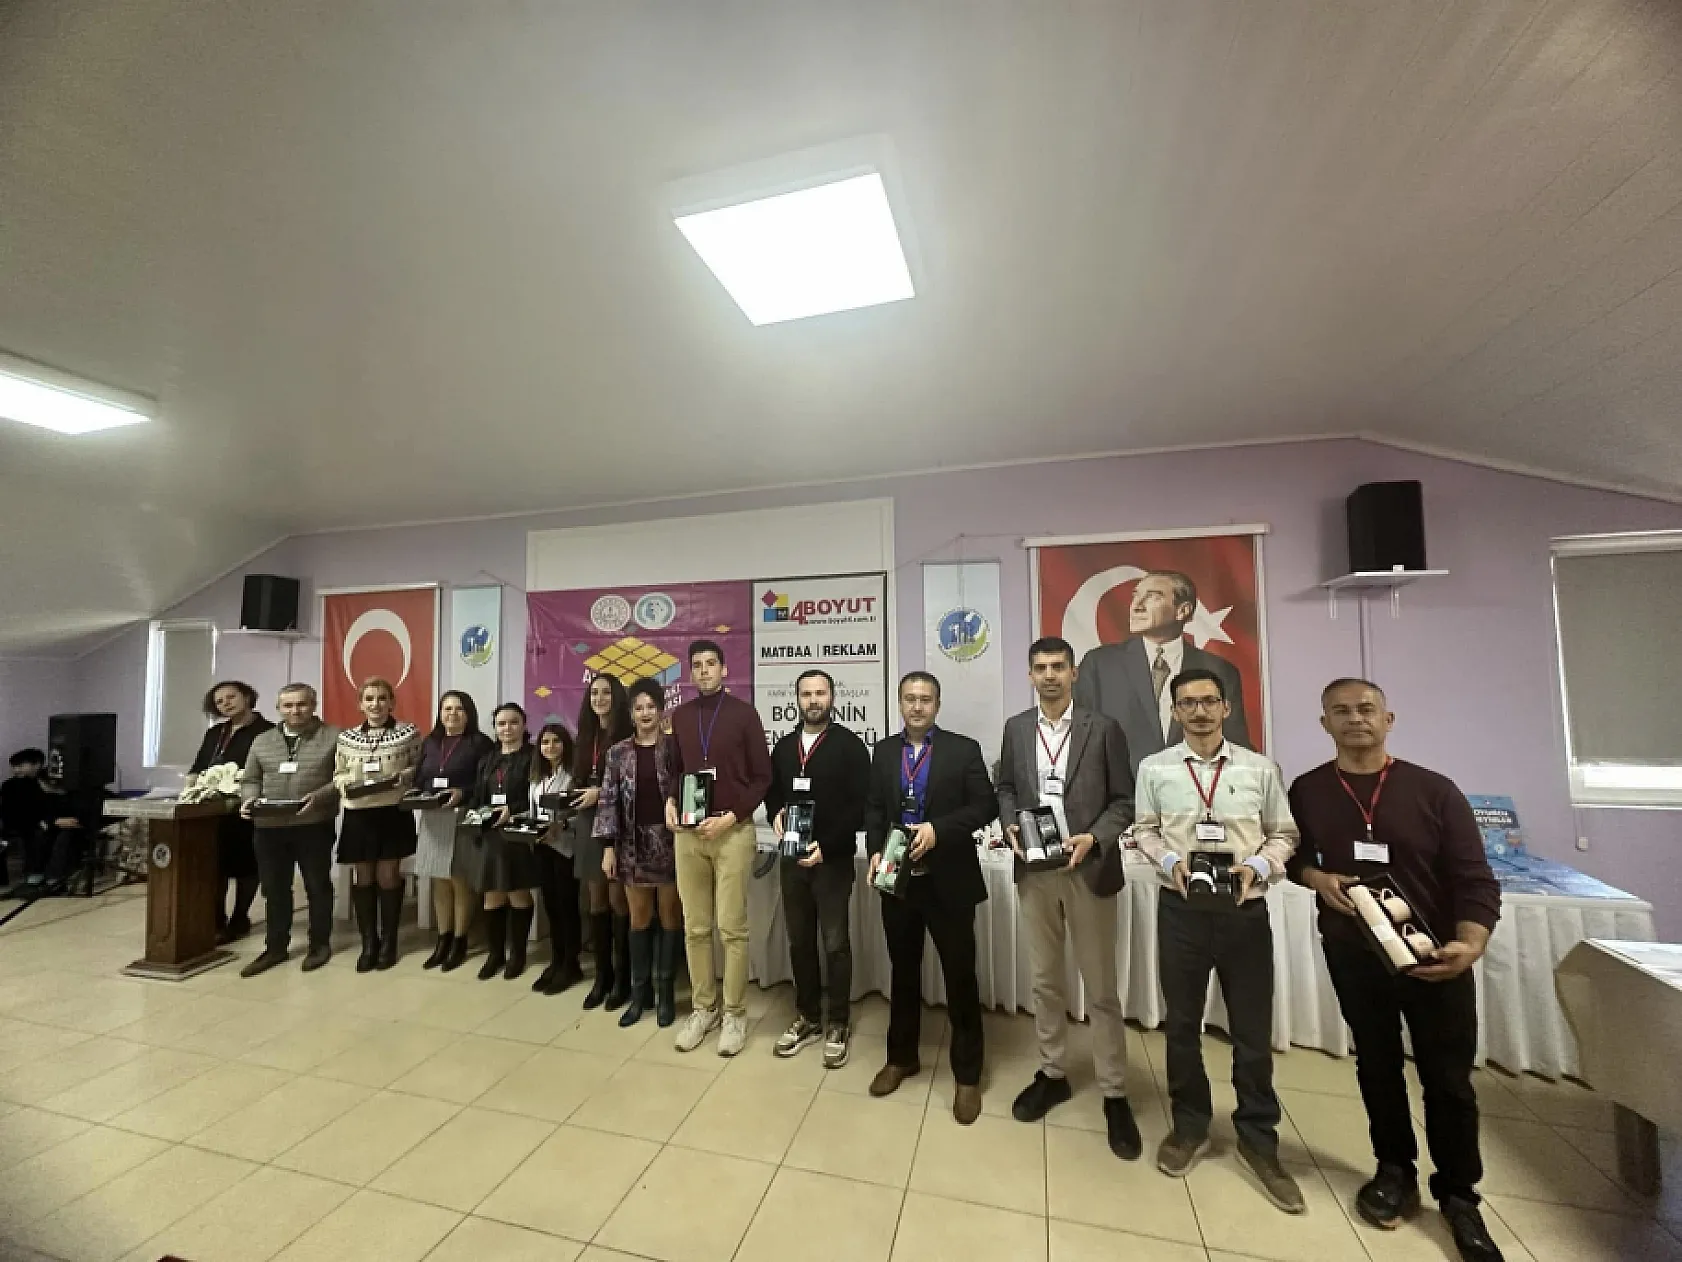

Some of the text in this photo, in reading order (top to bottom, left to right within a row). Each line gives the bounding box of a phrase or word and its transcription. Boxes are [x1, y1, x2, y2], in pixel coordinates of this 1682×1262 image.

[761, 643, 877, 658] MATBAA REKLAM
[772, 700, 866, 722] BÖNİN
